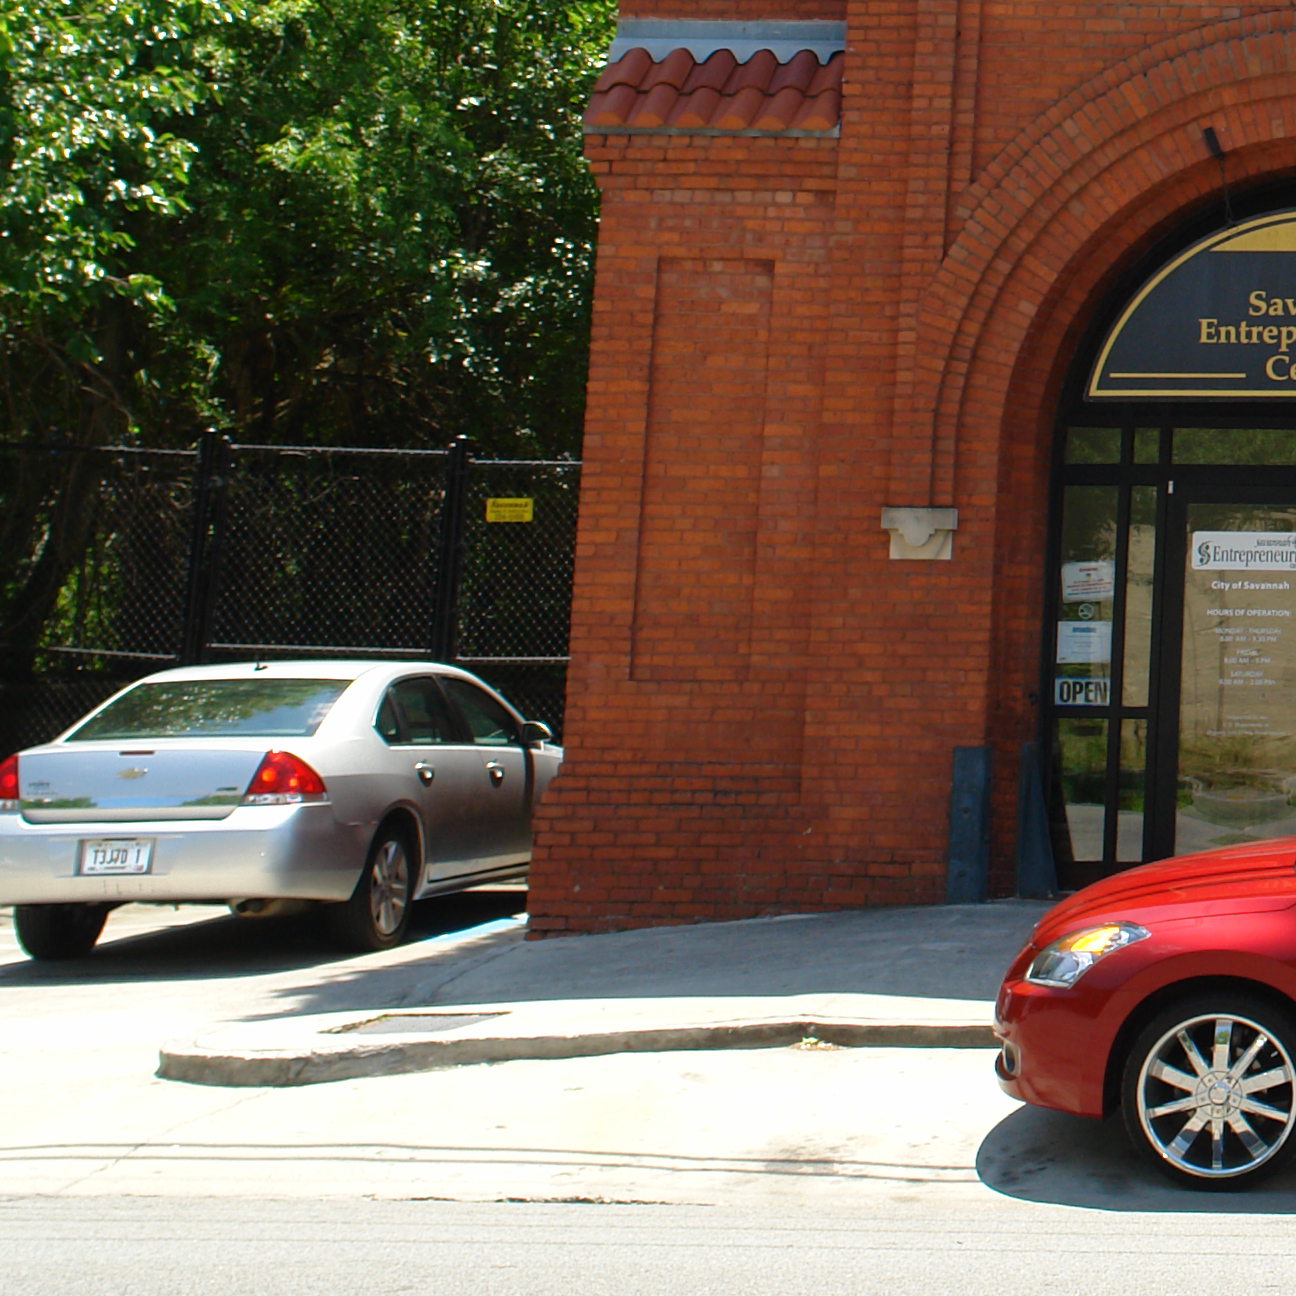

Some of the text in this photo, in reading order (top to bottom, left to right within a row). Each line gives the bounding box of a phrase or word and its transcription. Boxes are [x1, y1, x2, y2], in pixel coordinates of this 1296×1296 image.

[1211, 581, 1290, 592] City of Savannah
[1059, 681, 1108, 703] OPEN
